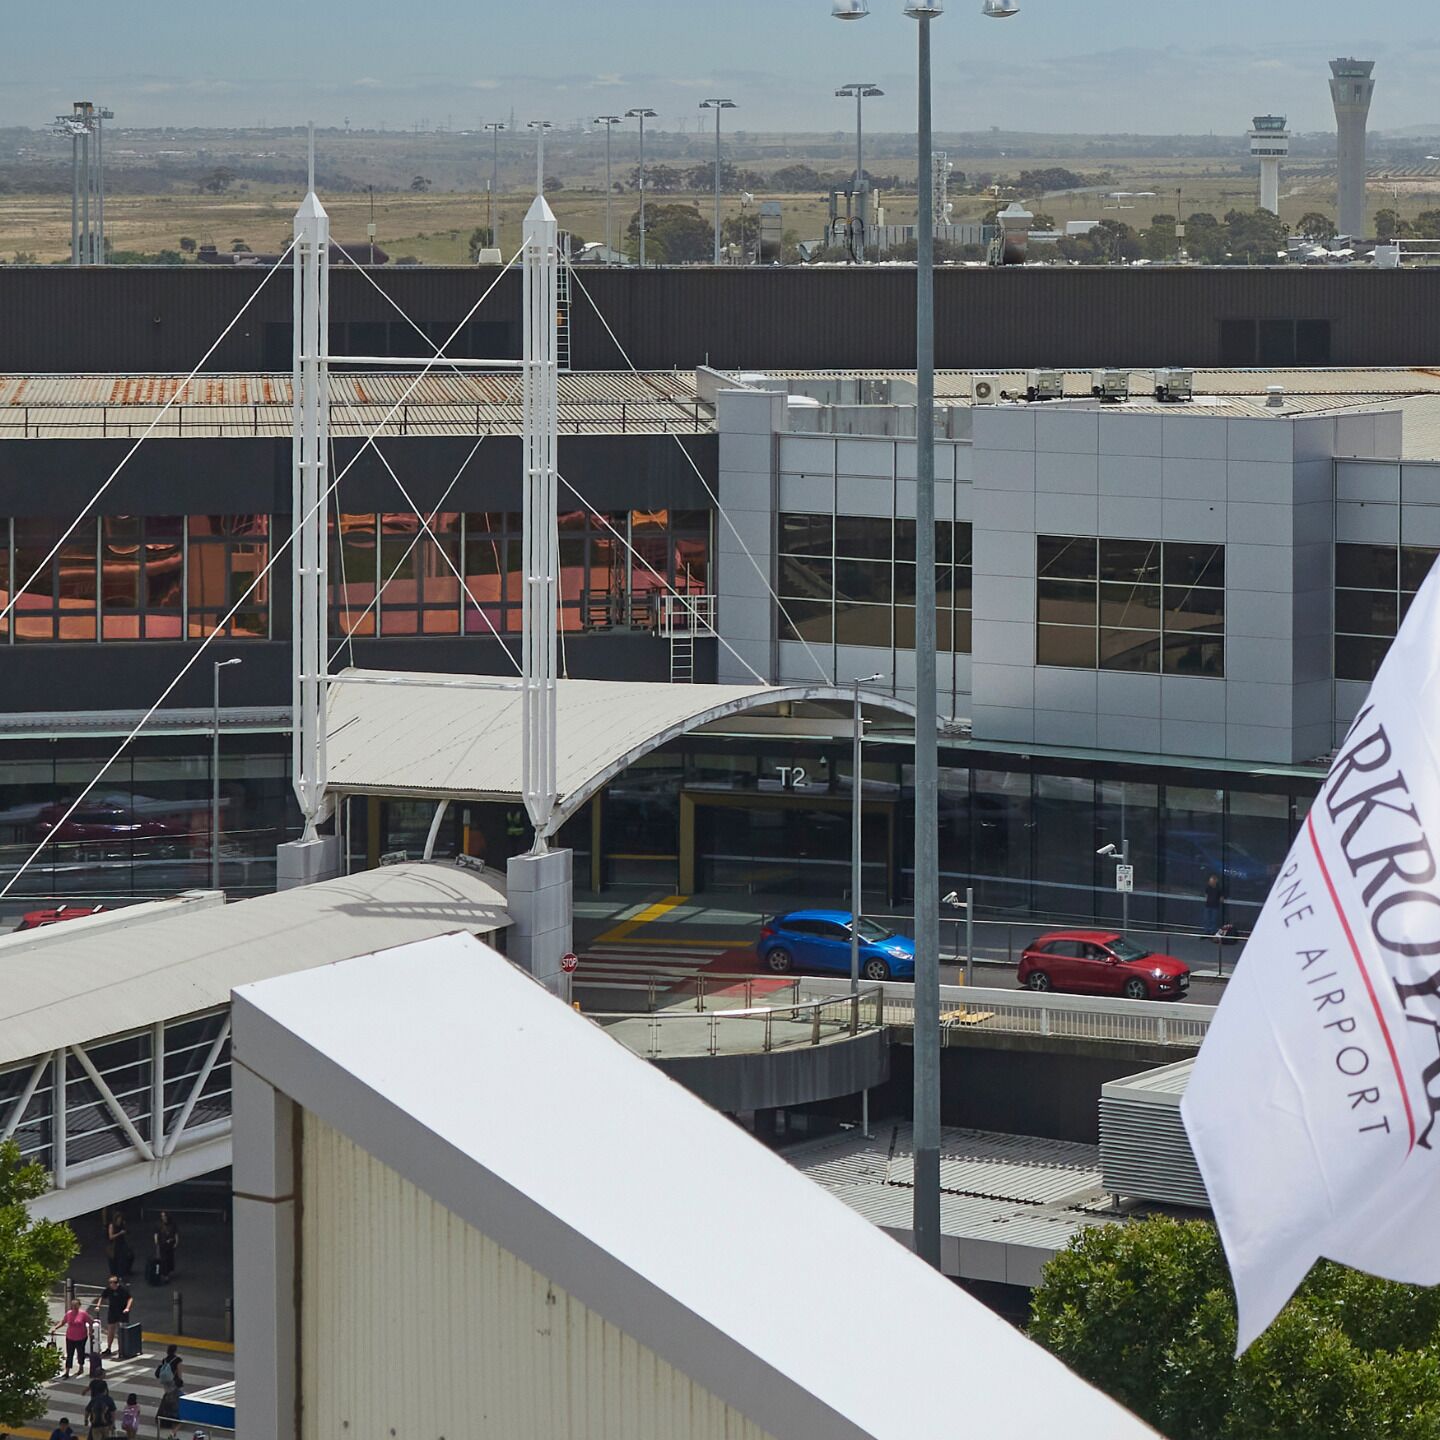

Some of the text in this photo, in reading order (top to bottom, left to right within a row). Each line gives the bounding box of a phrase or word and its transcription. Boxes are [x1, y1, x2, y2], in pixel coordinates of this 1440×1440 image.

[775, 766, 806, 787] T2
[562, 957, 576, 968] STOP
[1276, 853, 1391, 1135] RNE AIRPORT
